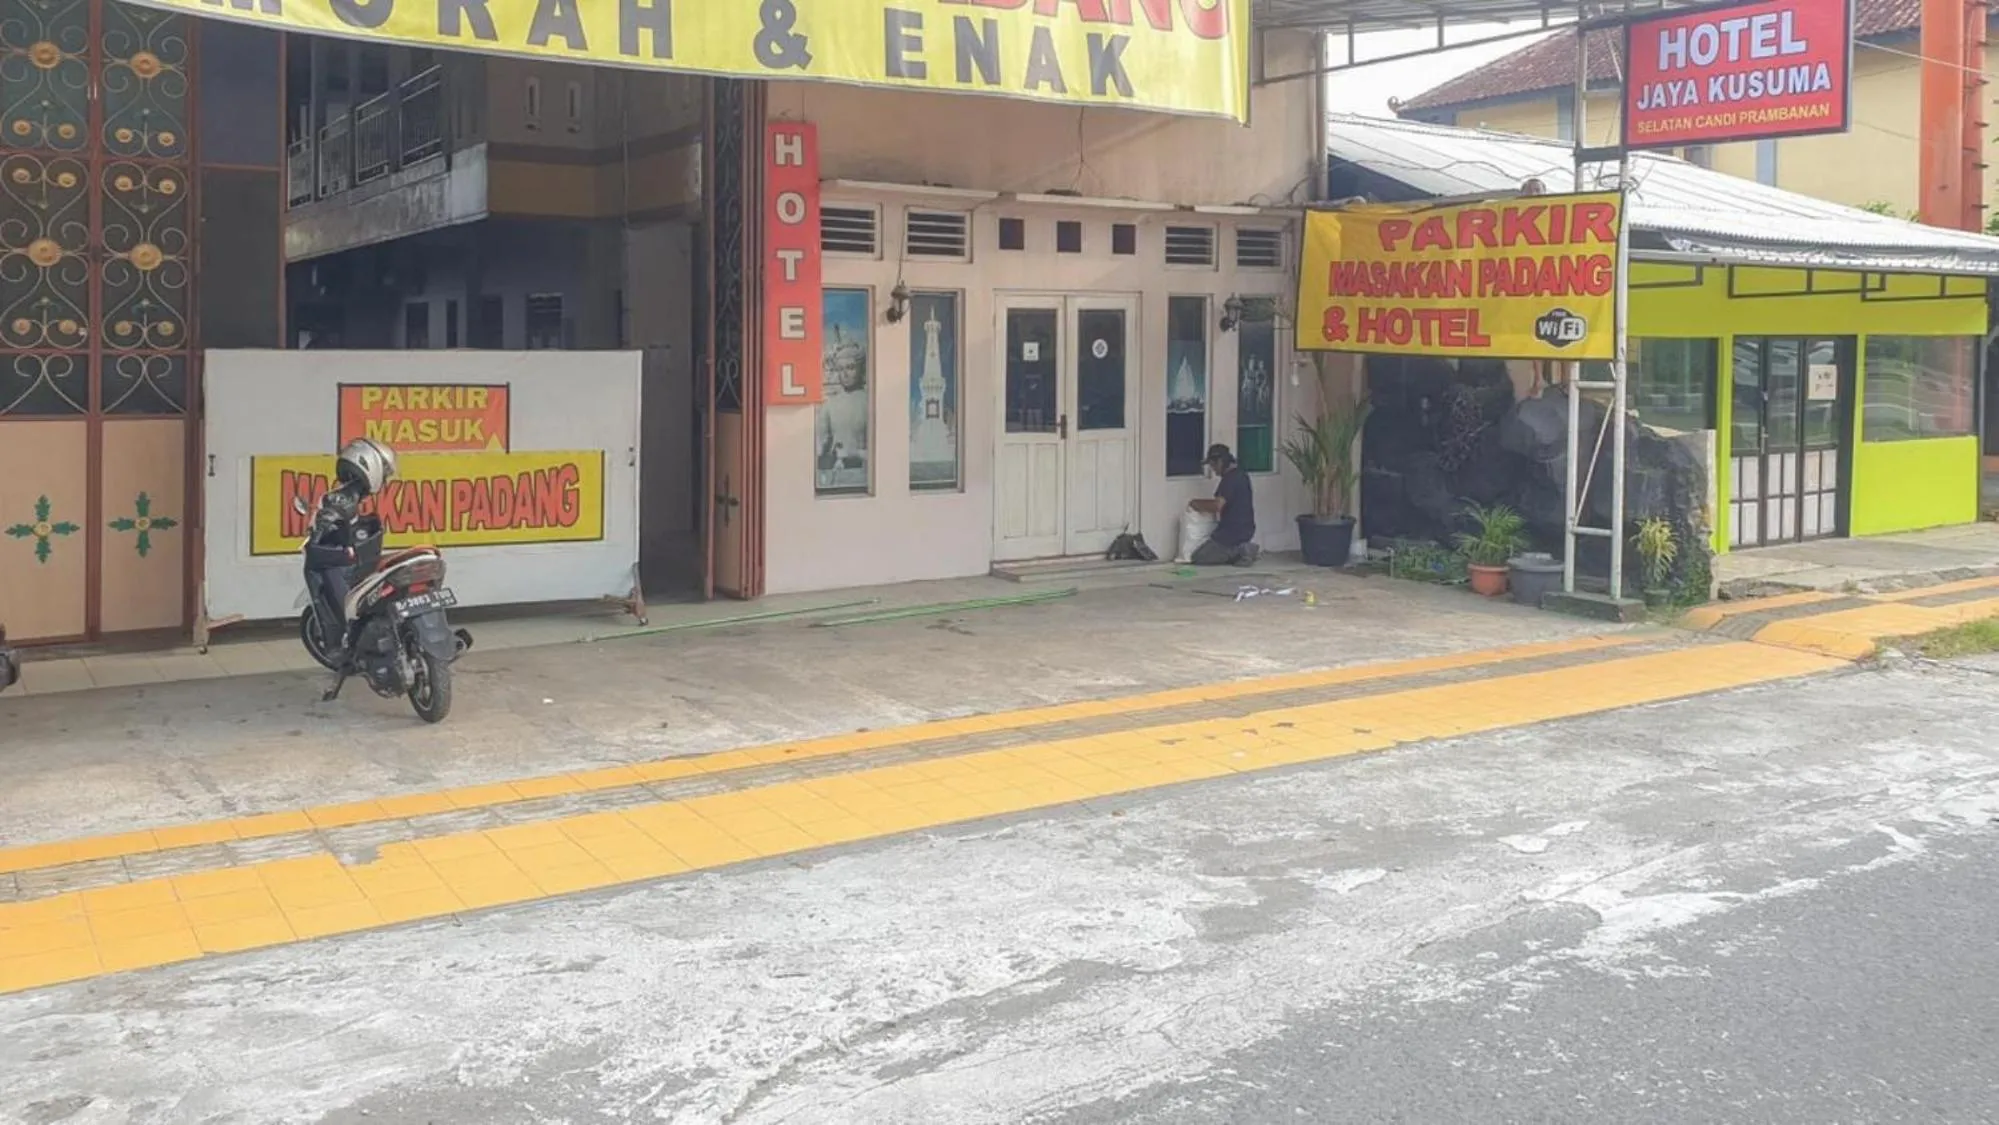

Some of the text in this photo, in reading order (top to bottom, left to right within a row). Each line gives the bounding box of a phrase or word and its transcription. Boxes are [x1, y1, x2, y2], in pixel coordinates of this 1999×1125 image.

[753, 0, 813, 70] &
[884, 7, 1134, 97] ENAK
[1658, 10, 1807, 71] HOTEL
[1637, 62, 1832, 110] JAYA KUSUMA
[1637, 102, 1830, 134] SELATAN CANDI PRAMBANAN
[1378, 202, 1616, 251] PARKIR
[774, 133, 805, 396] HOTEL
[1329, 254, 1613, 299] MASAKAN PADANG
[1322, 305, 1491, 347] & HOTEL
[361, 386, 488, 411] PARKIR
[365, 418, 485, 442] MASUK
[451, 462, 579, 531] PADANG
